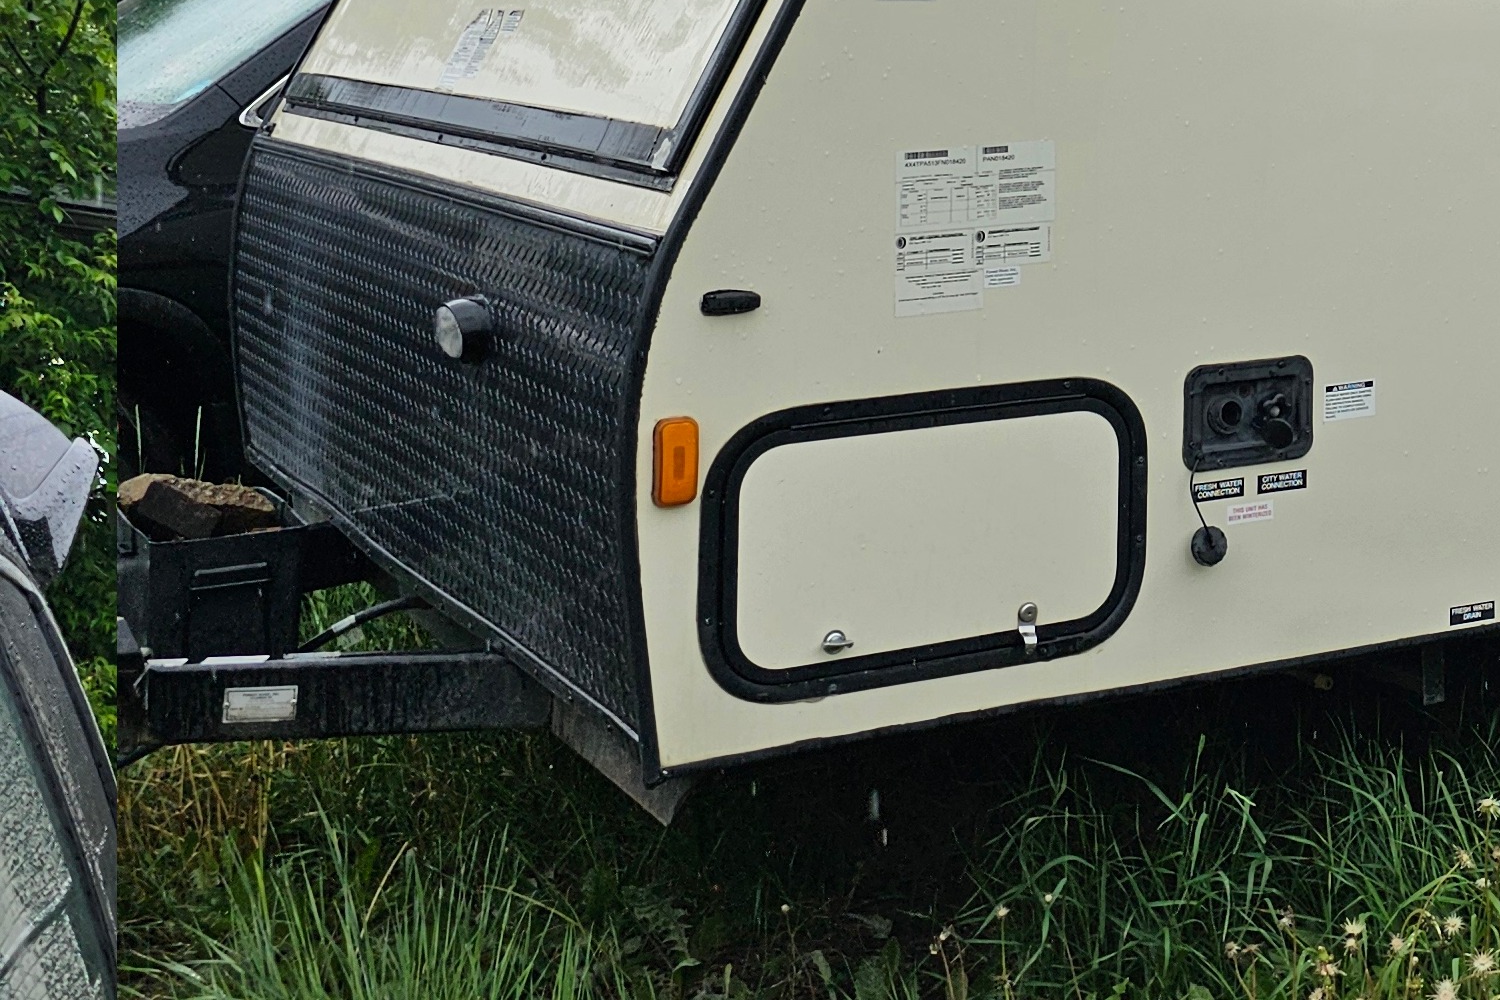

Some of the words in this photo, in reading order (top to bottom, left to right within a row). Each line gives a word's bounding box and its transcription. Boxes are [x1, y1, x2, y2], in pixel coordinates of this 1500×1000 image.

[1262, 474, 1278, 483] CITY
[1279, 471, 1303, 481] WATER
[1194, 482, 1218, 492] FRESH
[1219, 479, 1243, 488] WATER
[1261, 479, 1303, 490] CONNECTION
[1197, 488, 1240, 499] CONNECTION
[1463, 612, 1482, 620] DRAIN
